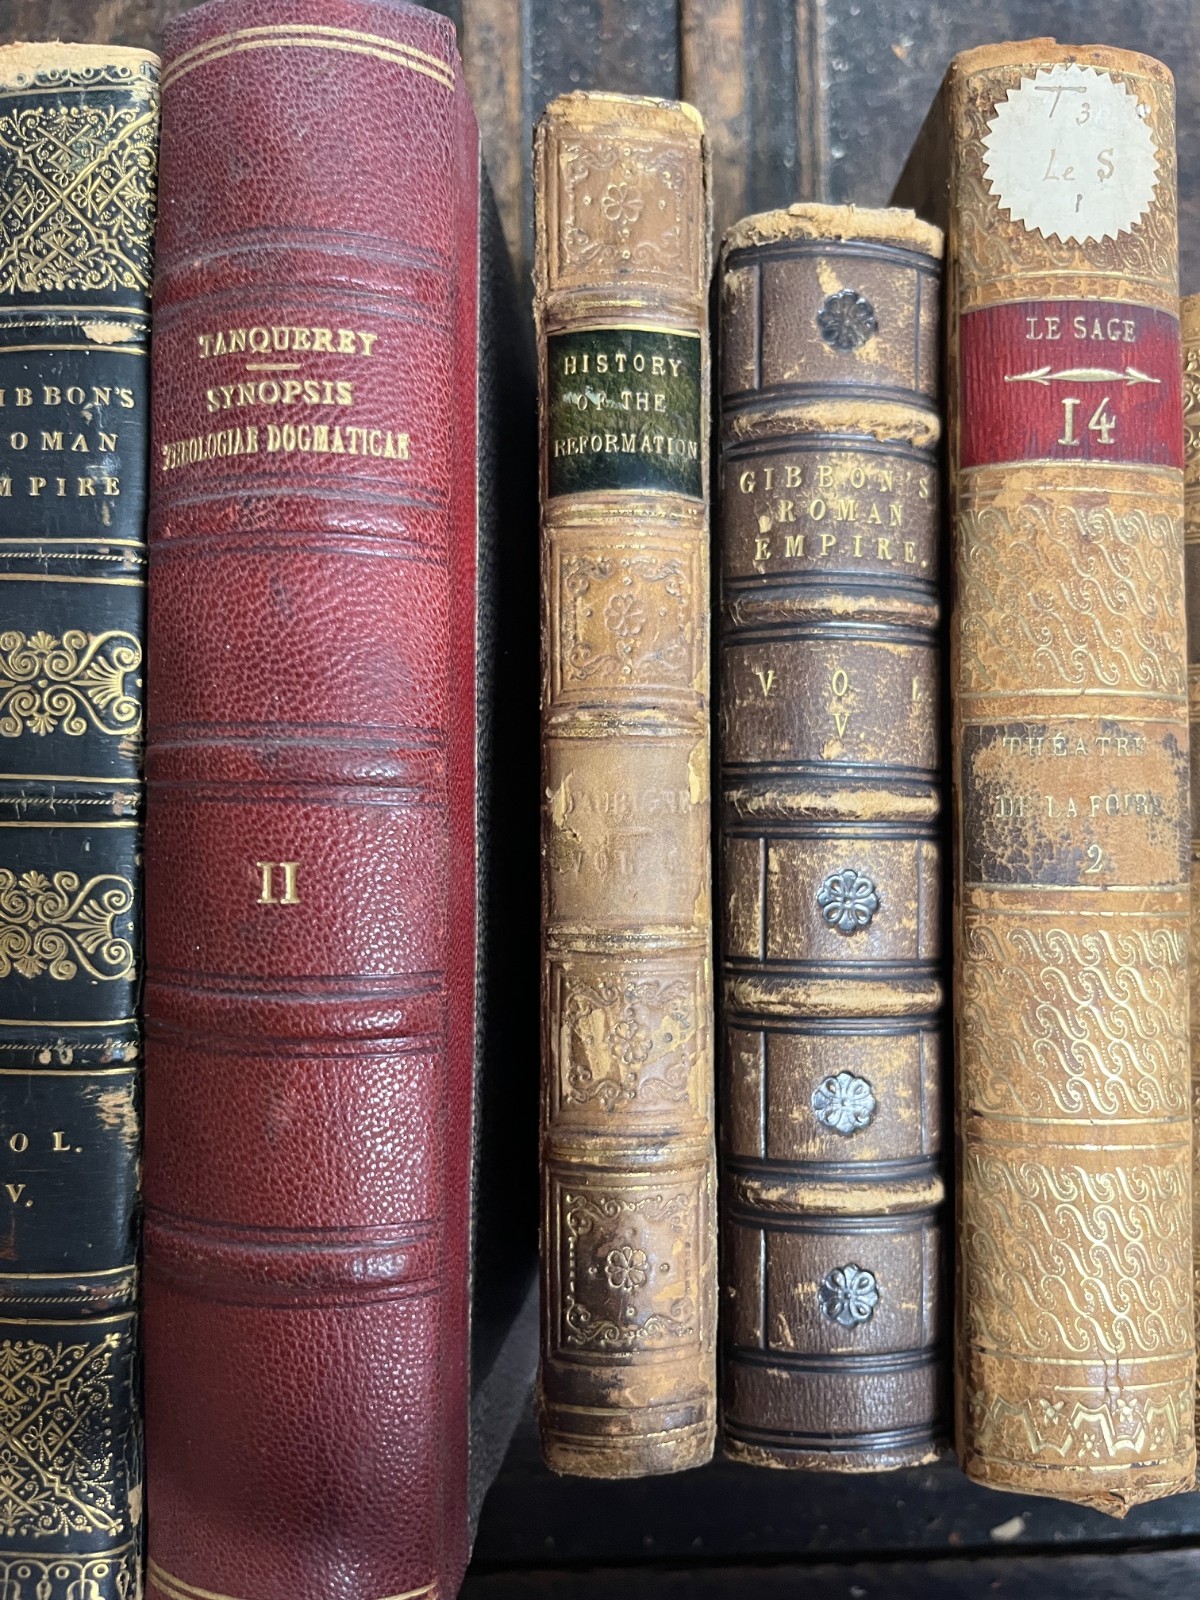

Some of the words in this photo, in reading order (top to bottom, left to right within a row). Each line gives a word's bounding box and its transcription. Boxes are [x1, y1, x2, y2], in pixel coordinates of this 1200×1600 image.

[1034, 86, 1088, 119] T
[1075, 102, 1091, 126] 3
[1042, 148, 1076, 182] Le
[1096, 148, 1115, 183] S
[198, 326, 377, 358] TANQUEREY
[1026, 317, 1062, 340] LE
[1073, 316, 1137, 342] SAGE
[563, 352, 682, 377] HISTORY
[206, 380, 354, 412] SYNOPSIS
[621, 390, 667, 413] THE
[267, 423, 410, 460] DOGMATICAE
[553, 433, 699, 460] REFORMATION
[738, 465, 930, 499] GIBBON'S
[778, 499, 904, 527] ROMAN
[754, 533, 929, 568] EMPIRE.
[1044, 795, 1078, 818] LA
[1084, 843, 1103, 873] 2
[256, 861, 301, 905] II
[5, 1183, 33, 1207] V.
